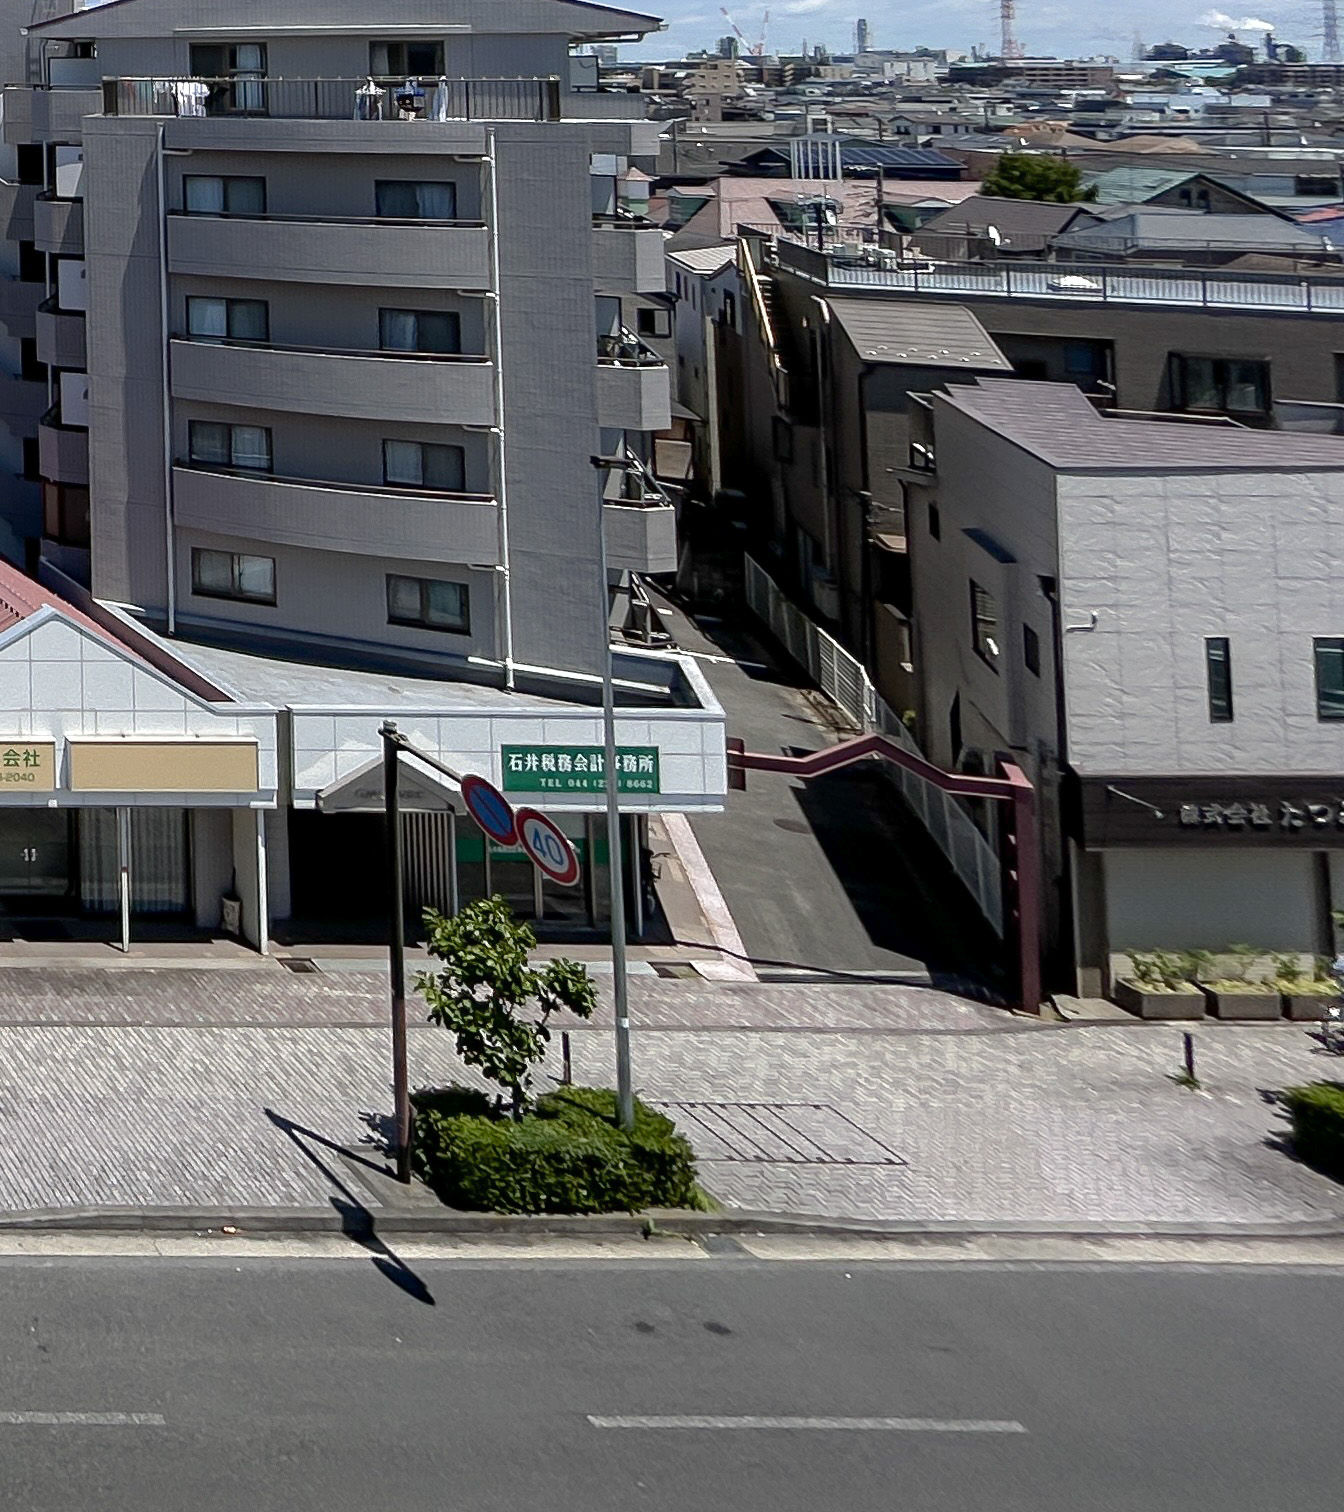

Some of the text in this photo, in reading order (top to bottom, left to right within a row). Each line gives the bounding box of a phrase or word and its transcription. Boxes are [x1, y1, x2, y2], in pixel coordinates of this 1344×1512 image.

[539, 778, 562, 788] TEL
[1279, 798, 1344, 827] たつ
[532, 828, 562, 866] 40
